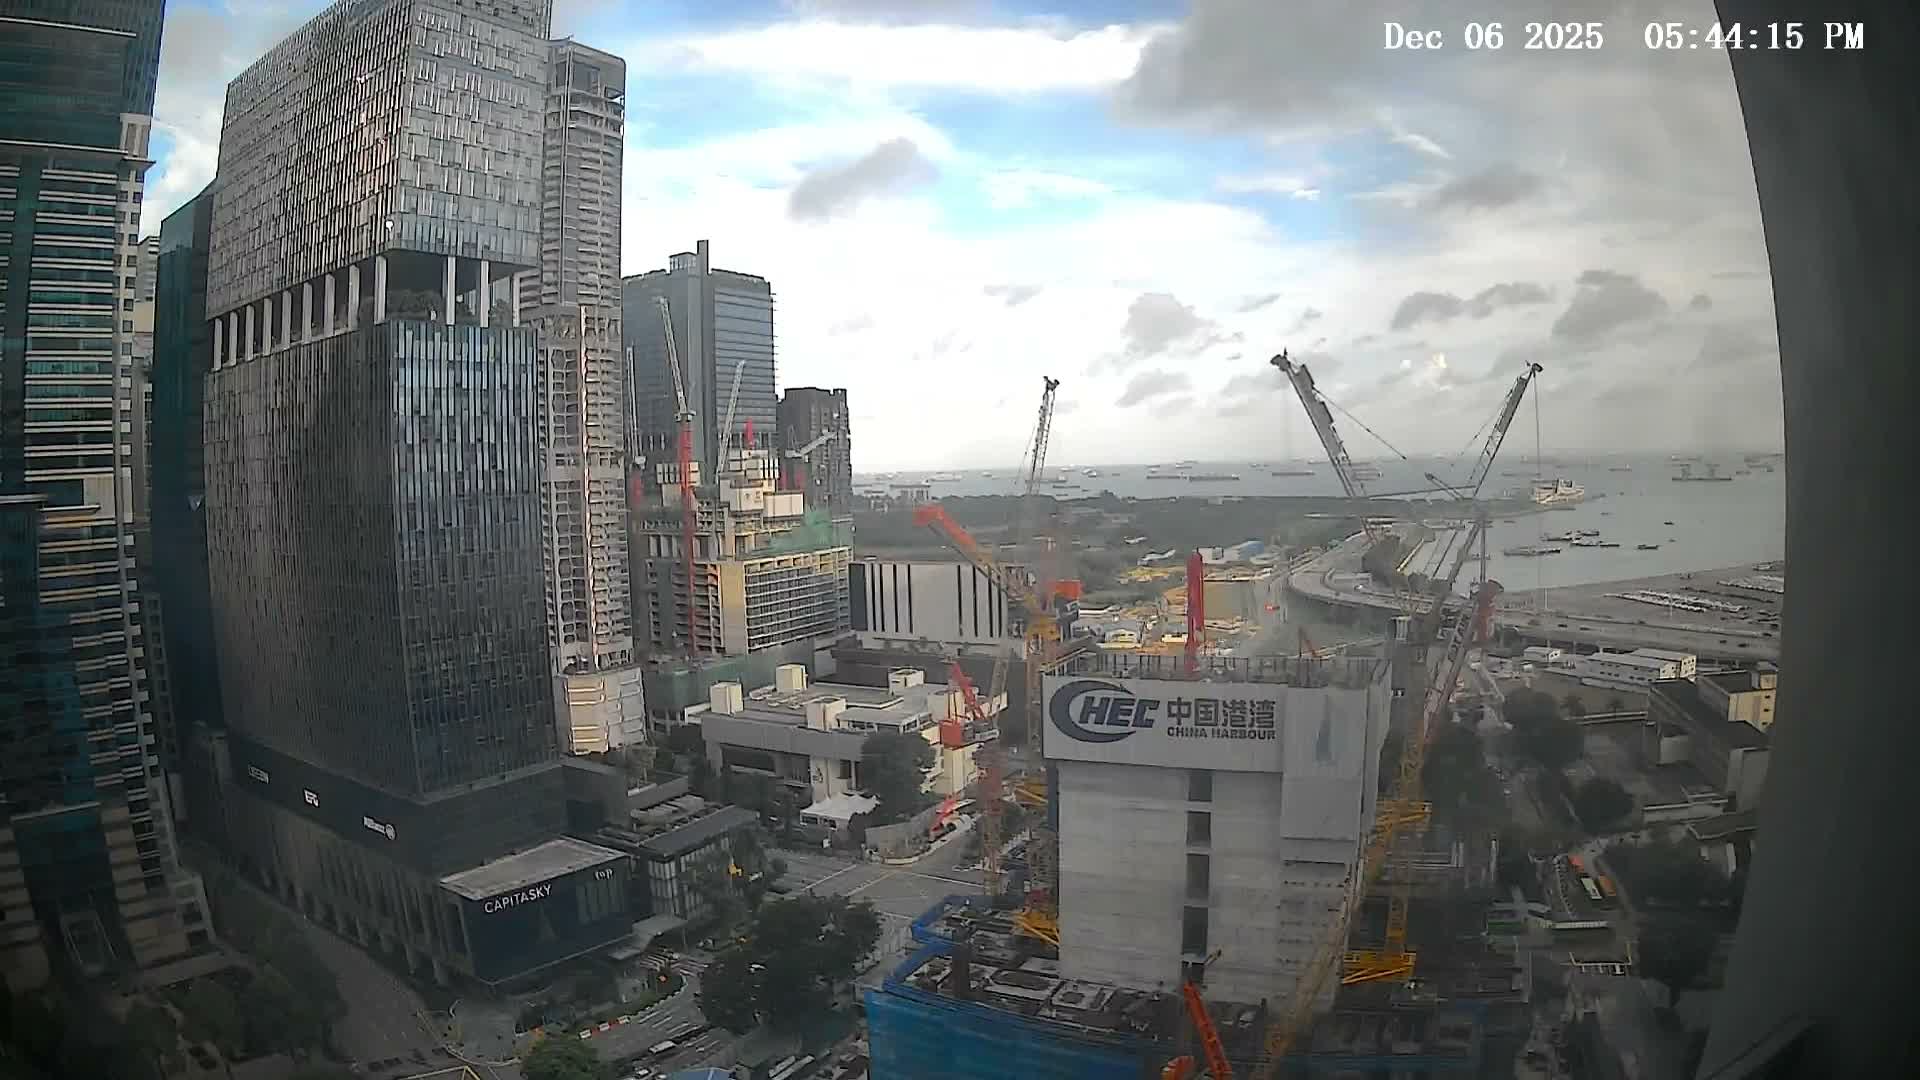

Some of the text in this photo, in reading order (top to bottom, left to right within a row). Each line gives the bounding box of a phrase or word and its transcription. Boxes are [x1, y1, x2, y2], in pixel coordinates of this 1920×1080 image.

[1167, 696, 1276, 729] 中国港湾
[1167, 727, 1276, 741] CHINA HARBOUR
[484, 884, 552, 914] CAPITASKY
